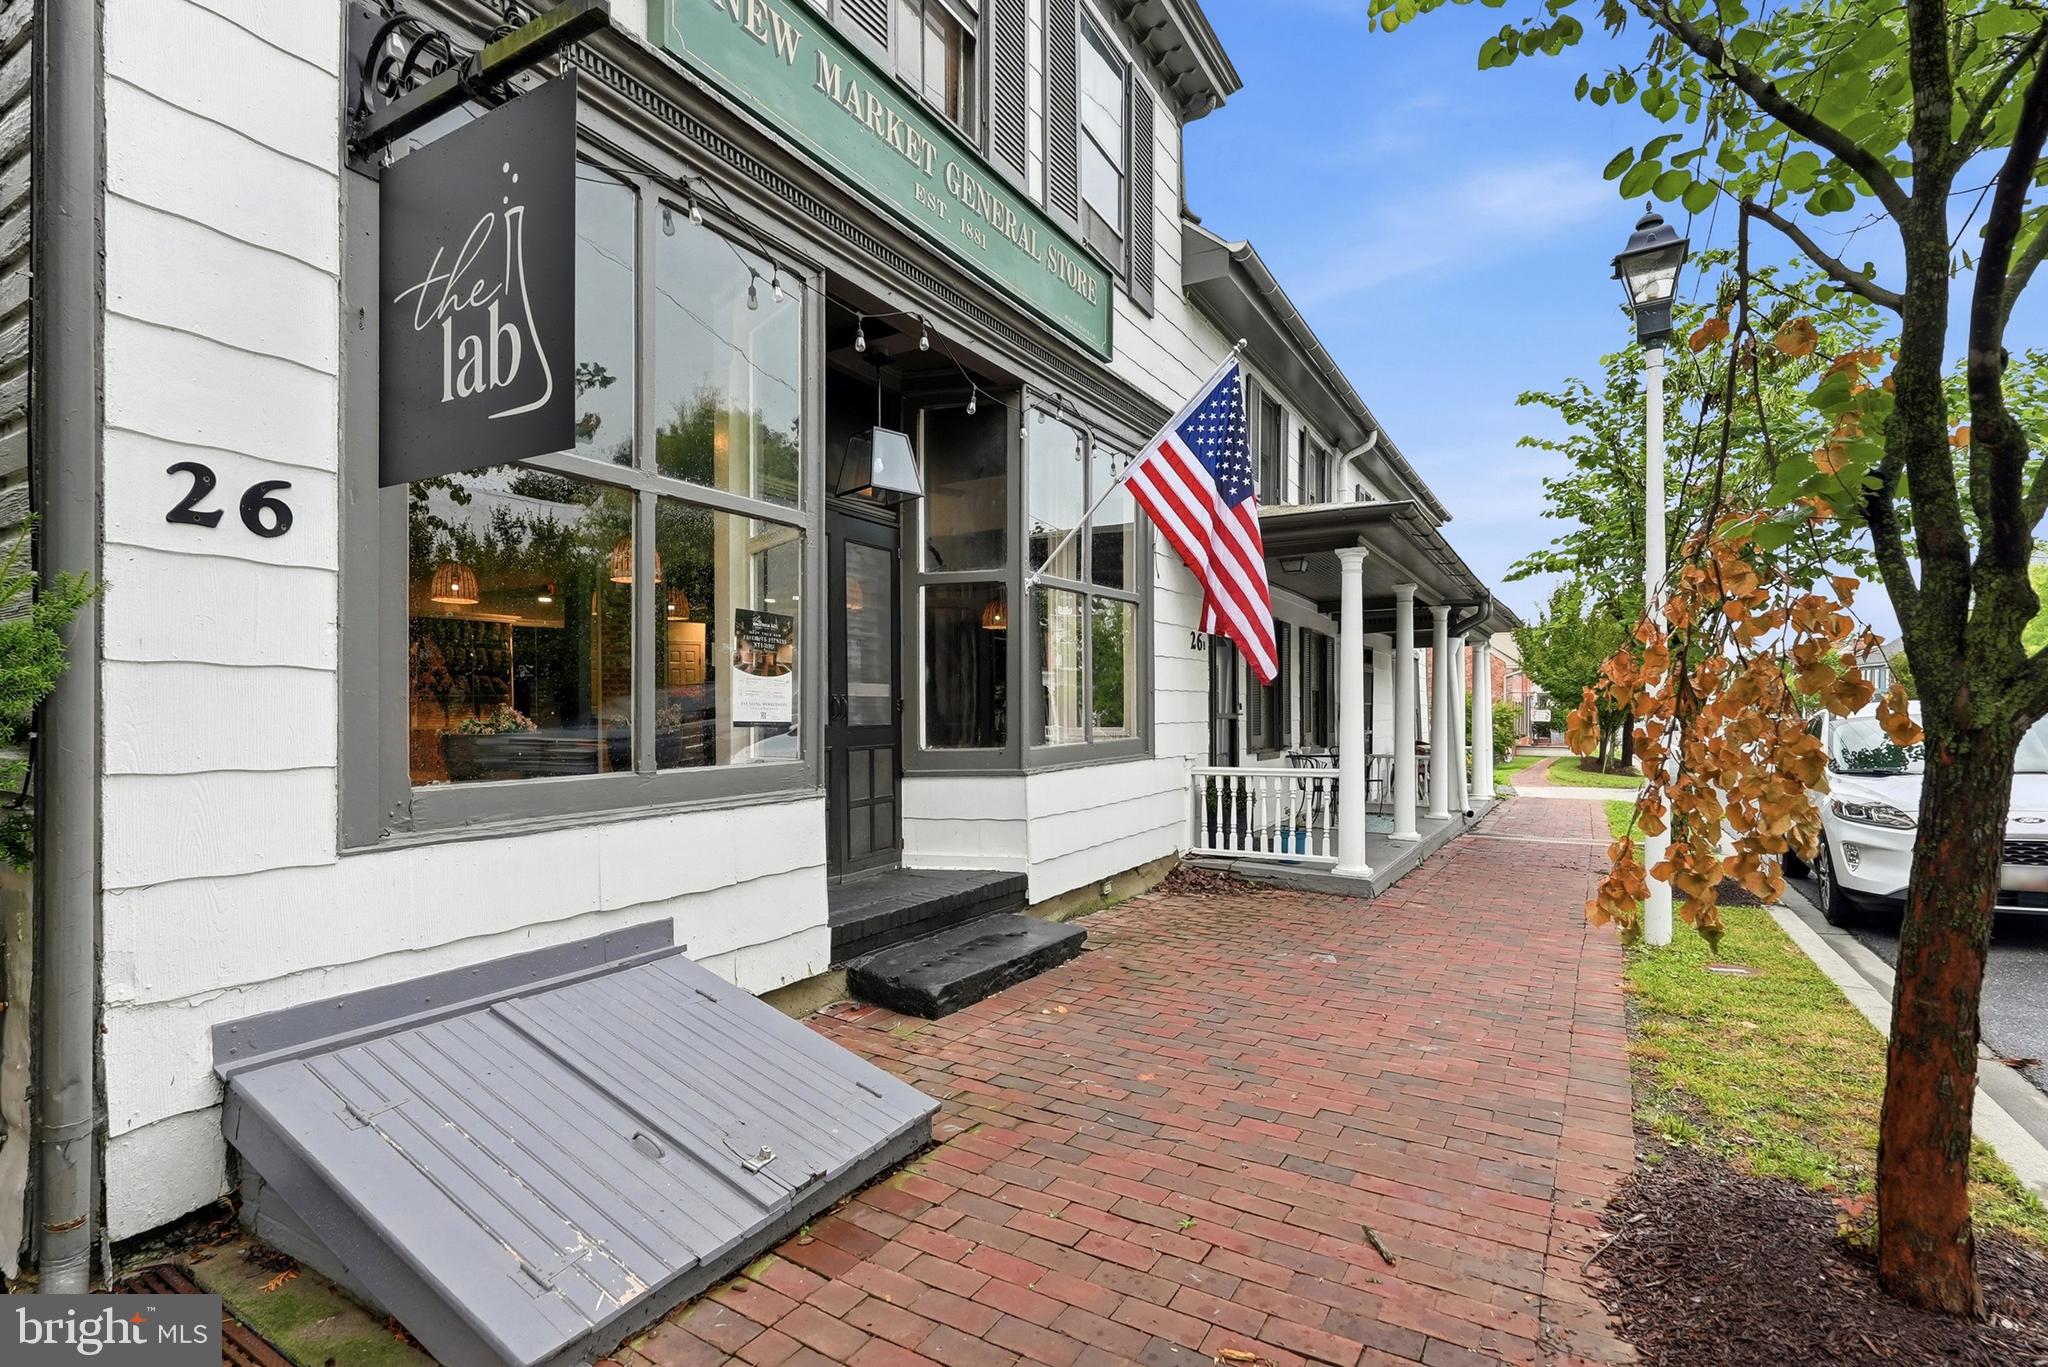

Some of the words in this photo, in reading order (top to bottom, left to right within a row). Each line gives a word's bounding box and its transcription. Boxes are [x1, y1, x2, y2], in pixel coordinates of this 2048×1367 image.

[814, 49, 937, 177] MARKET
[946, 161, 1041, 262] GENERAL
[1048, 243, 1097, 305] STORE
[913, 182, 952, 224] EST.
[960, 218, 987, 250] 1881
[393, 212, 503, 332] the
[441, 299, 522, 403] lab
[166, 461, 293, 538] 26
